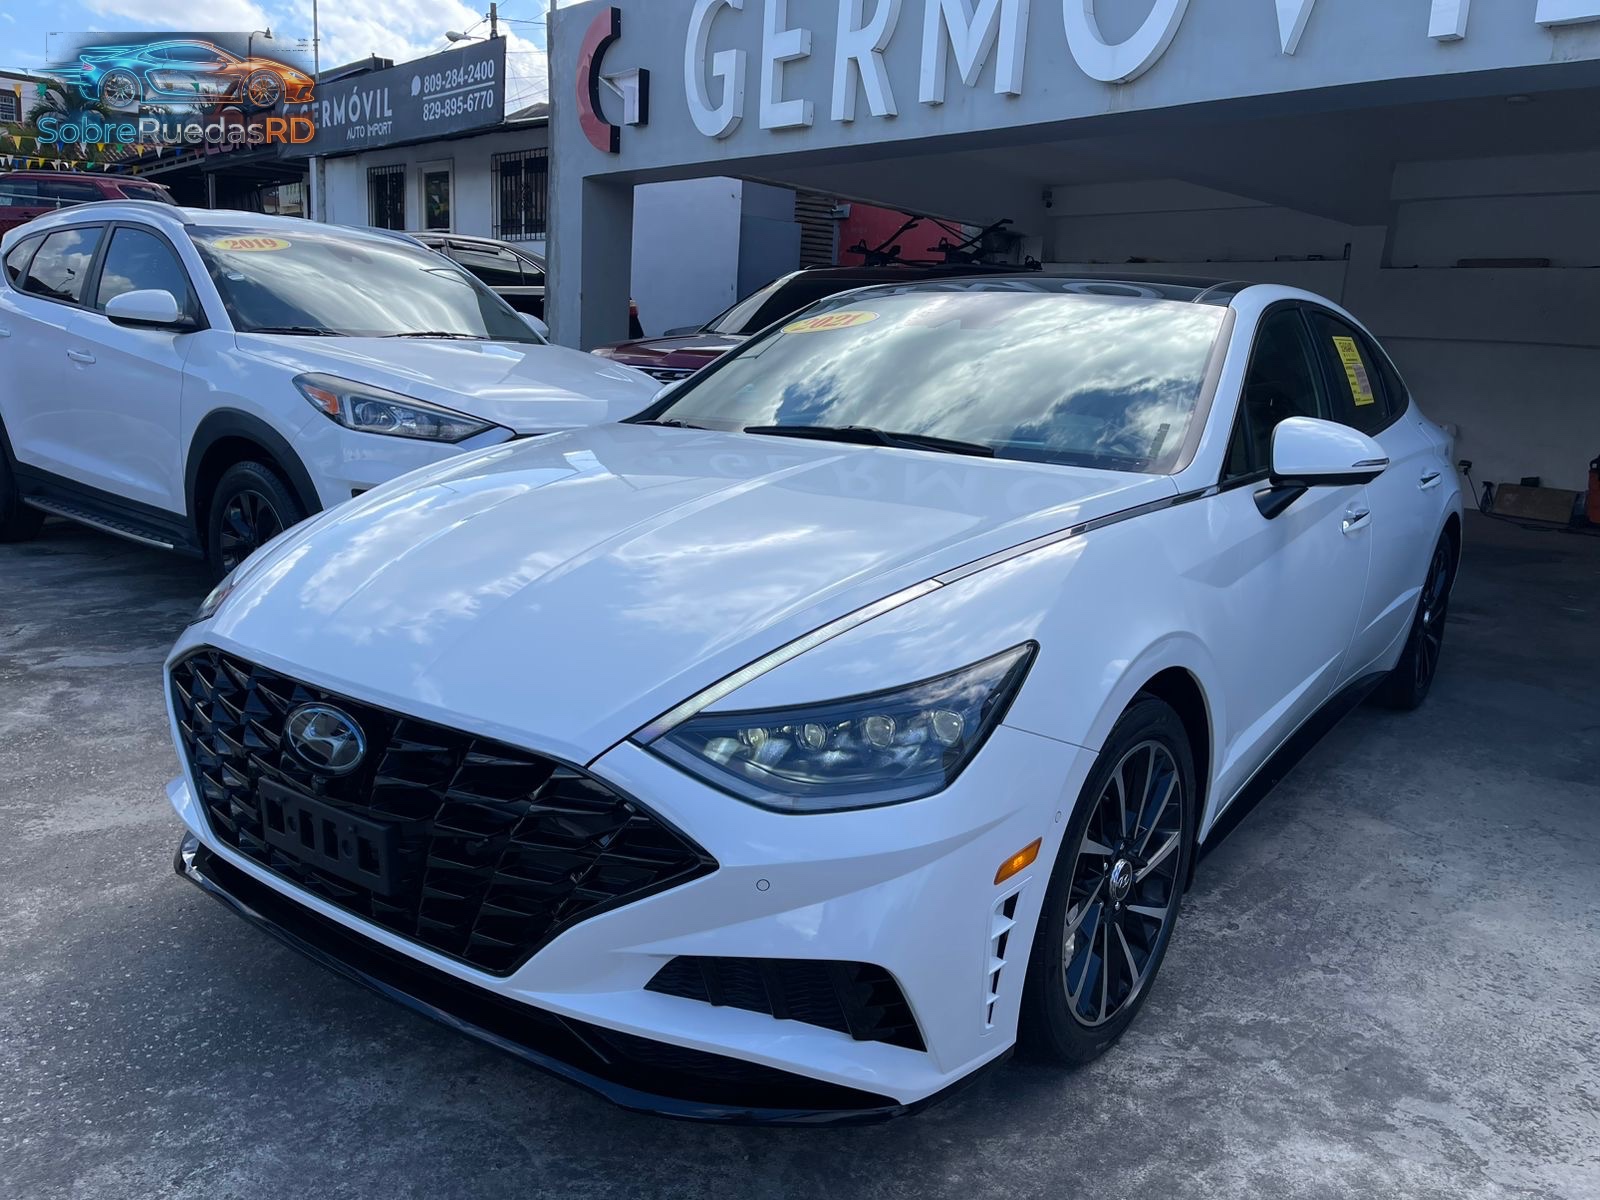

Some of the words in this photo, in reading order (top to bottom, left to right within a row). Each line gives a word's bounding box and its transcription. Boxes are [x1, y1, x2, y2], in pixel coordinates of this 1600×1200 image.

[424, 59, 495, 93] 809-284-2400
[422, 89, 494, 121] 829-895-6770
[346, 125, 365, 140] AUTO
[224, 238, 277, 249] 2019
[790, 313, 866, 332] 2021
